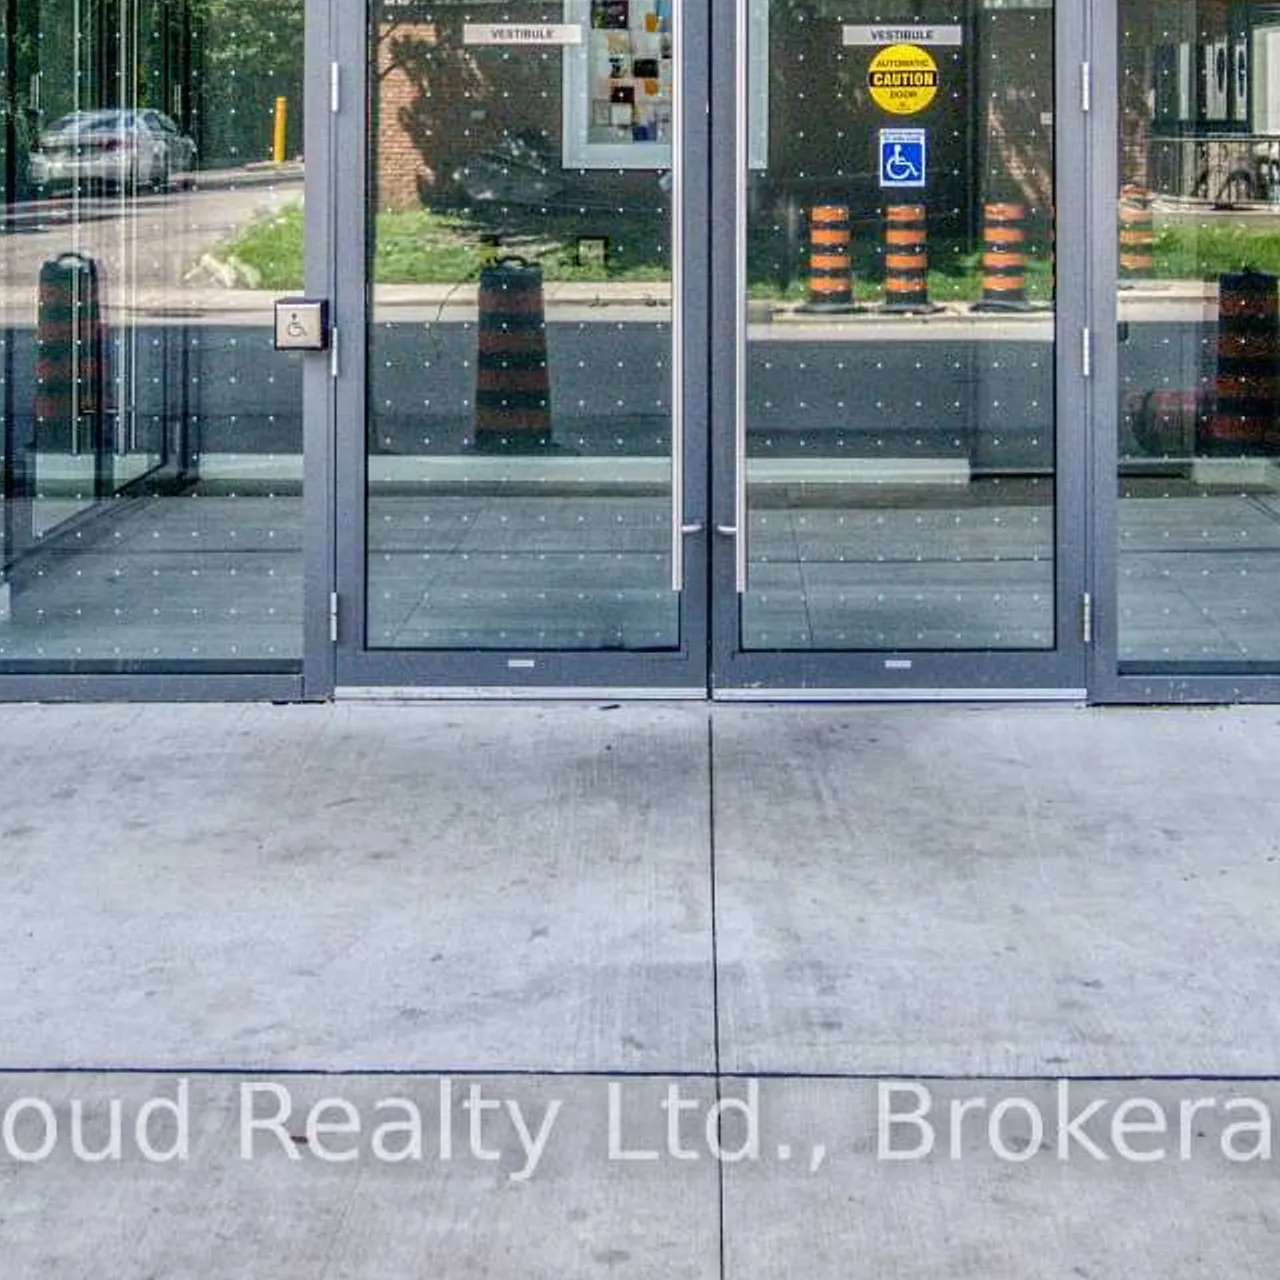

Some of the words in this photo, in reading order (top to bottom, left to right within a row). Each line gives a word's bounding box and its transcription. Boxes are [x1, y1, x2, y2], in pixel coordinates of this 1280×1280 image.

[491, 29, 553, 39] VESTIBULE
[870, 30, 934, 40] VESTIBULE
[876, 59, 929, 68] AUTOMATIC
[873, 72, 934, 86] CAUTION
